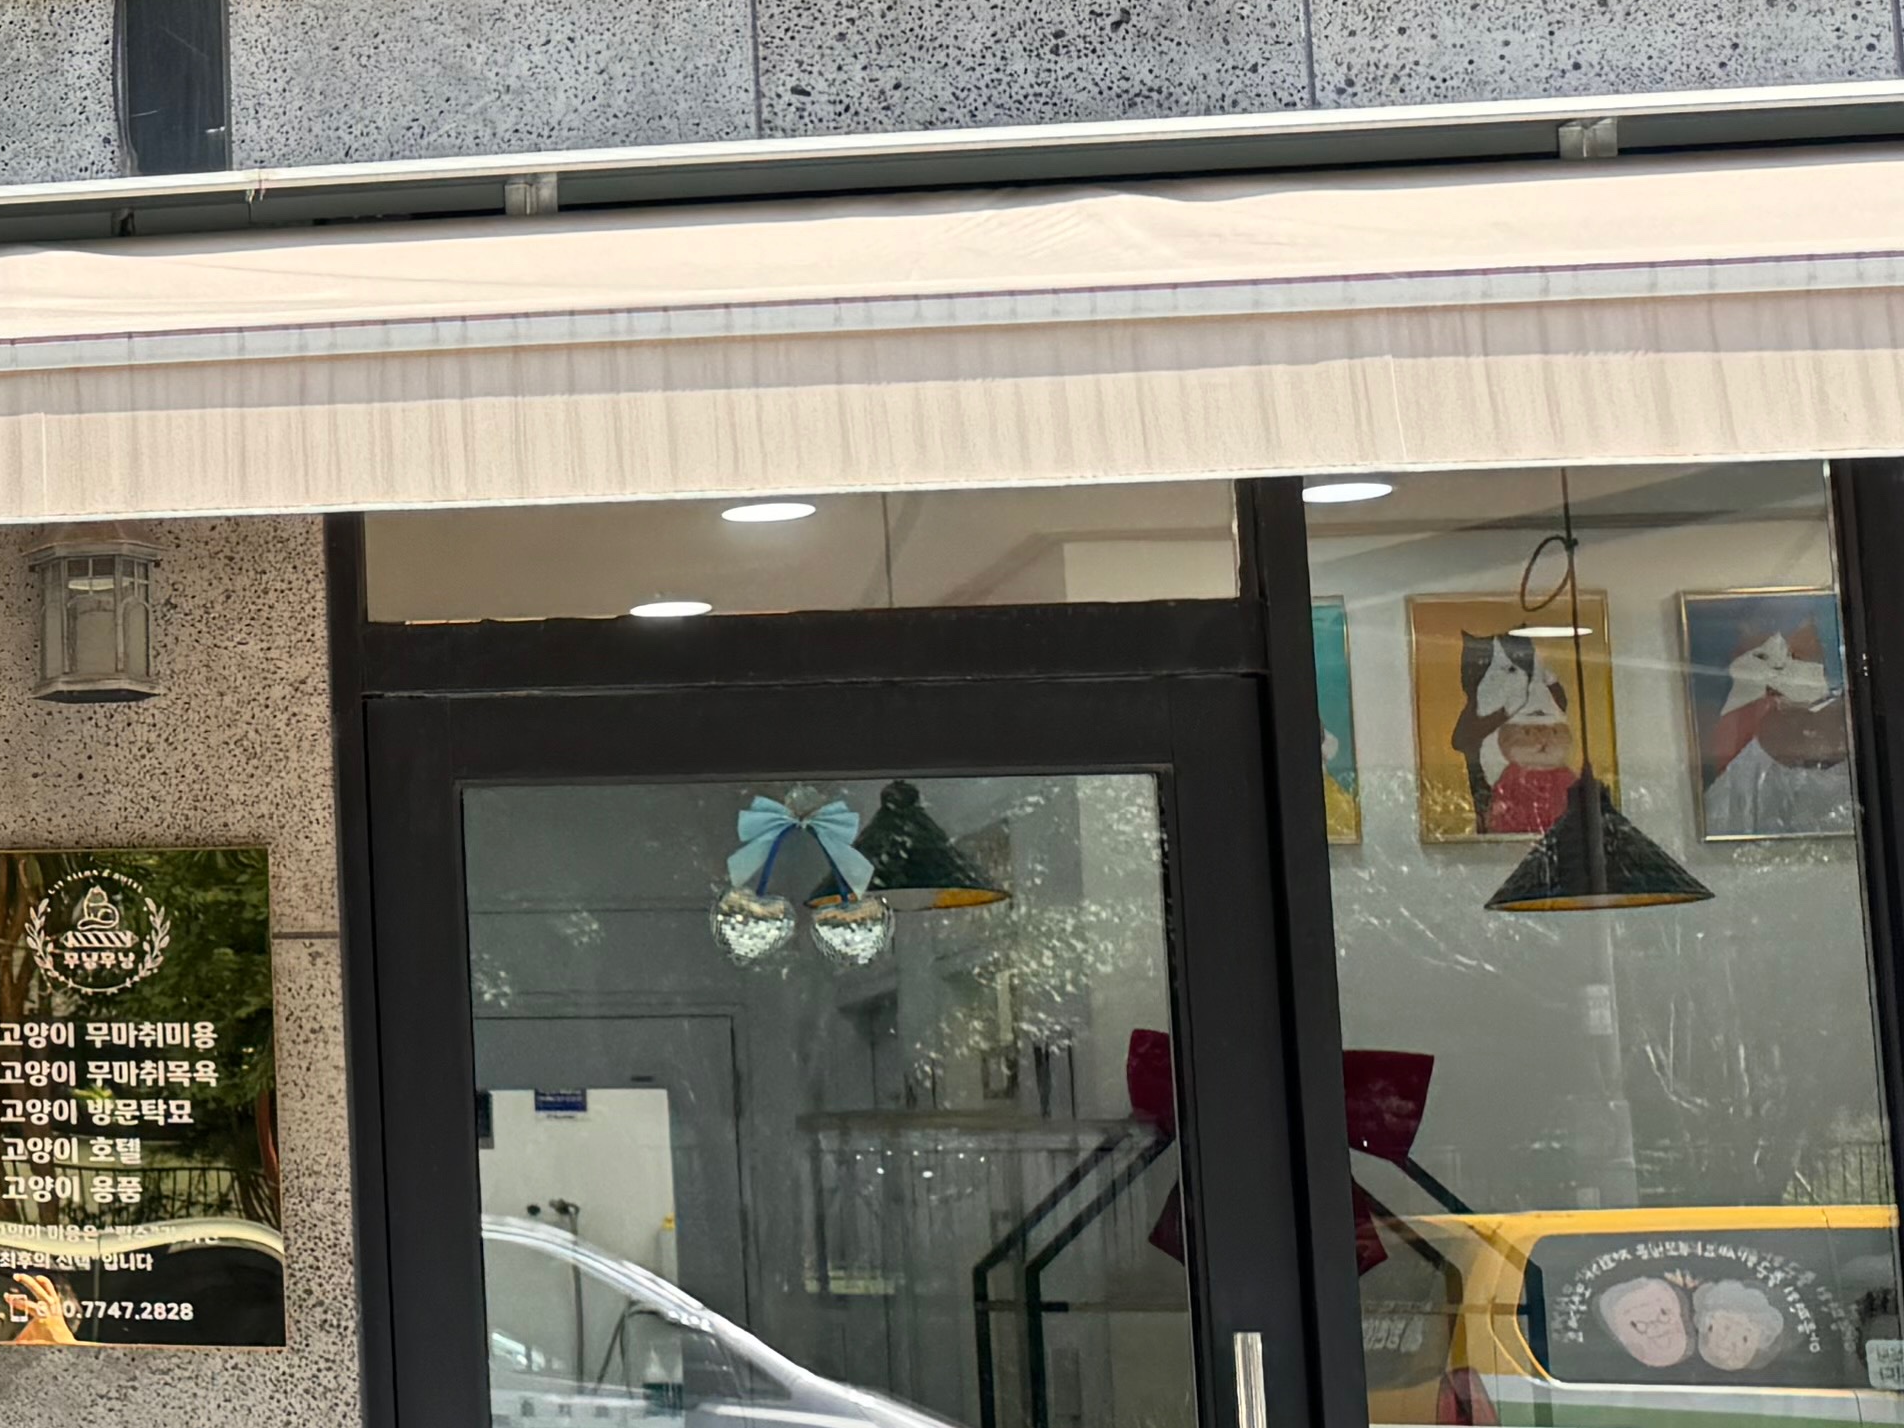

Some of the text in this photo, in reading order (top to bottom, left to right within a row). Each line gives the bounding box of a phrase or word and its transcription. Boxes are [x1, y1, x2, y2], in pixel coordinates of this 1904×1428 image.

[85, 1021, 218, 1049] 무마취미용
[86, 1060, 219, 1087] 무마취목욕
[0, 1099, 194, 1126] 고양이 방문탁묘
[1, 1136, 142, 1164] 고양이 호텔
[2, 1175, 142, 1204] 고양이 용품
[36, 1301, 194, 1321] 00.7747.2828
